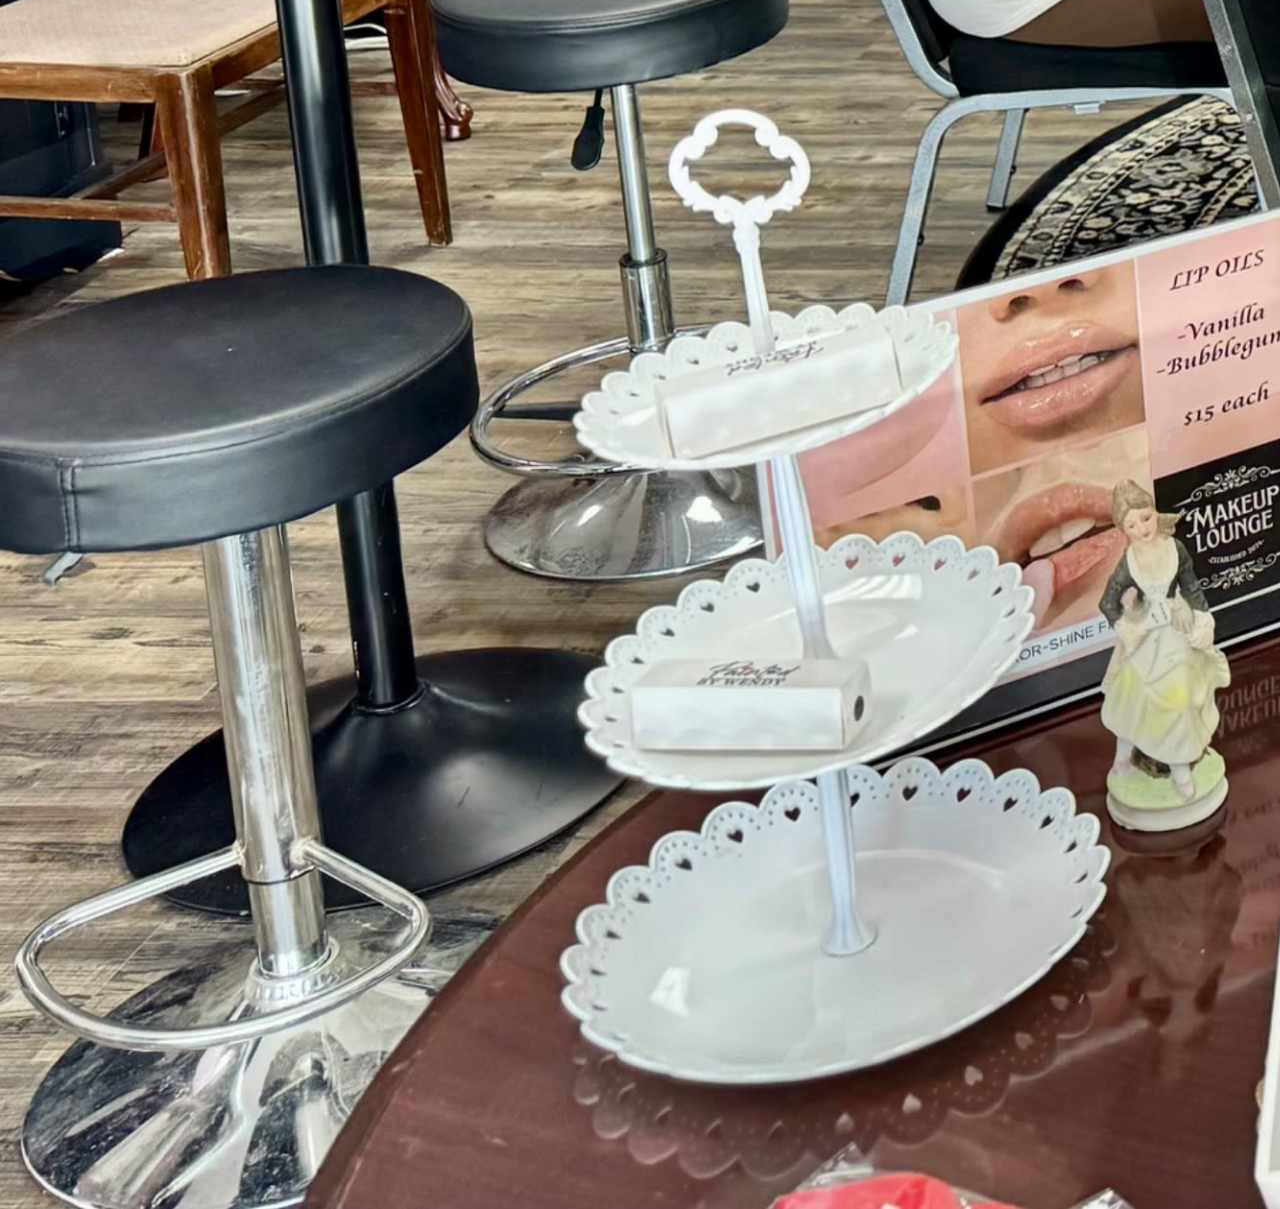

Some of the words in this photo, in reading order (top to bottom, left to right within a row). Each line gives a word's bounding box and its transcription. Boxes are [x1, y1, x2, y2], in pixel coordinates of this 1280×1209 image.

[1169, 266, 1212, 292] LIP
[1215, 249, 1265, 278] OILS
[1183, 404, 1217, 427] $15
[1221, 381, 1270, 416] each
[1186, 485, 1280, 539] MAKEUP
[1195, 509, 1274, 553] LOUNGE
[1016, 625, 1096, 664] OR-SHINE
